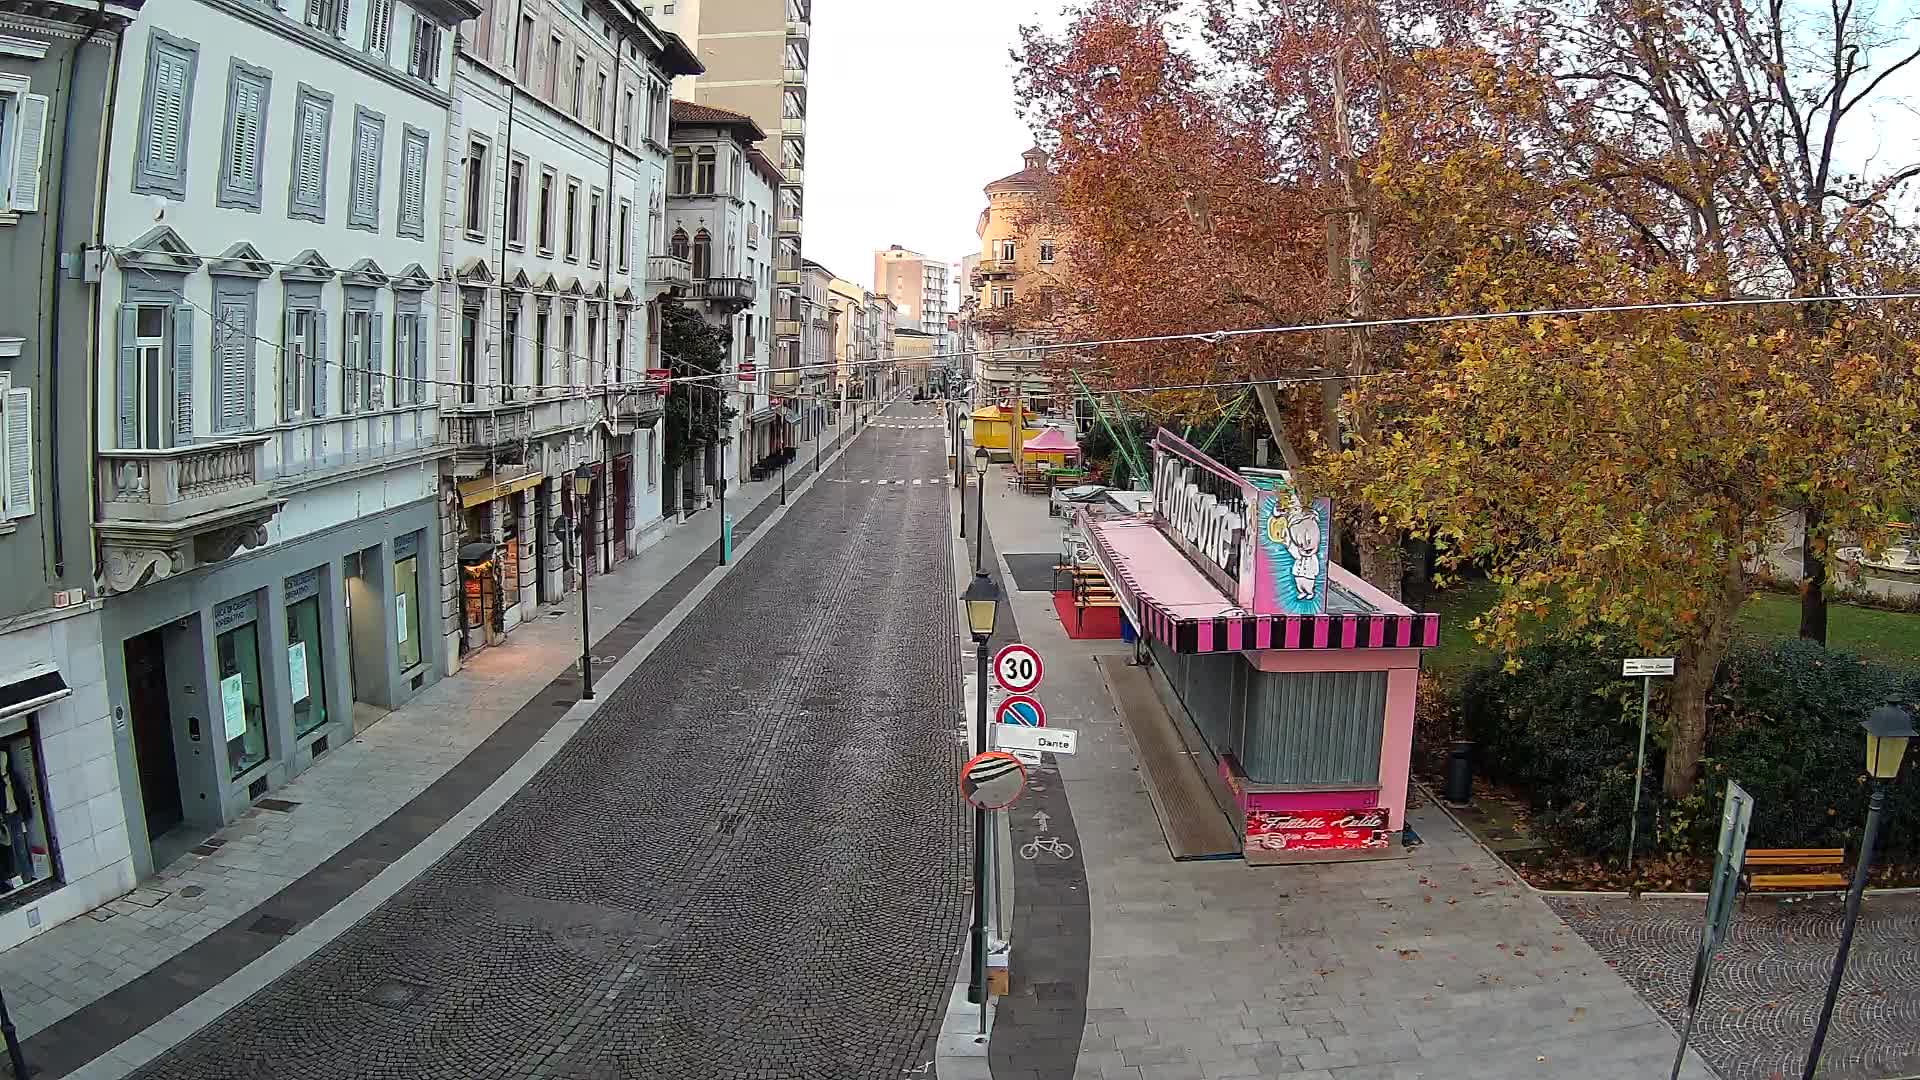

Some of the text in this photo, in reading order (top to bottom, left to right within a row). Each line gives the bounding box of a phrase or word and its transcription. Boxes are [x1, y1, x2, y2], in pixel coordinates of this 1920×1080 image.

[1005, 658, 1033, 680] 30
[1038, 738, 1069, 749] Dante
[1331, 815, 1382, 829] Calde
